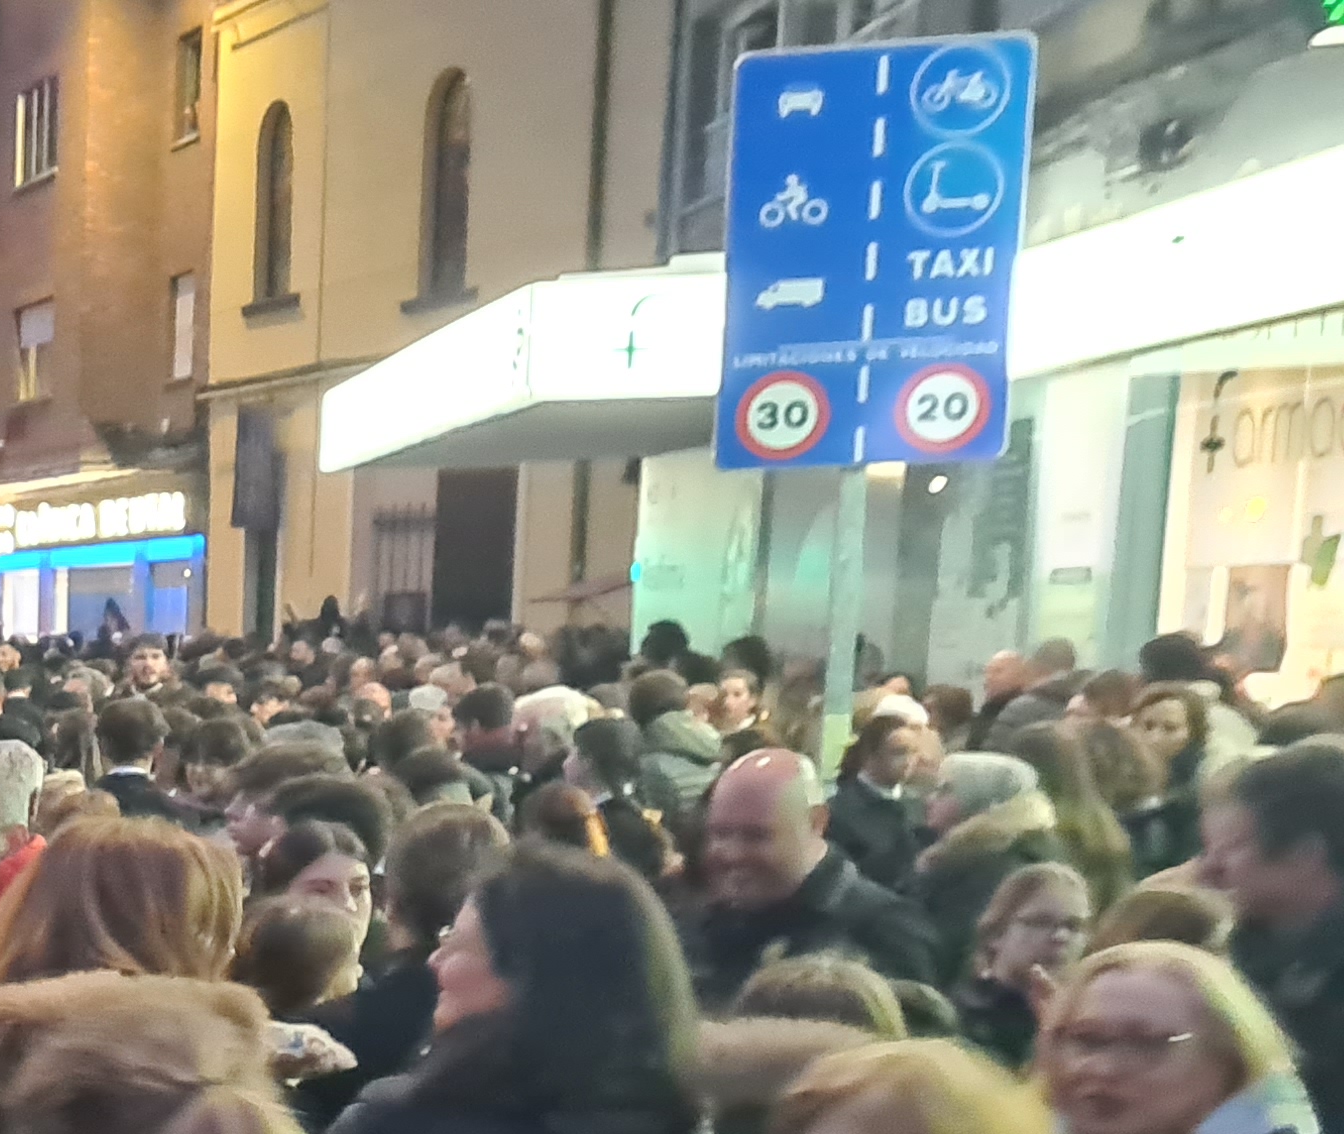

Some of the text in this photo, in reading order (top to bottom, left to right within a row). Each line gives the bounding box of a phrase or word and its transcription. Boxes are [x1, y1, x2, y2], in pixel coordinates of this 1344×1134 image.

[907, 247, 994, 279] TAXI
[904, 296, 987, 327] BUS
[756, 401, 809, 430] 30
[917, 392, 969, 422] 20
